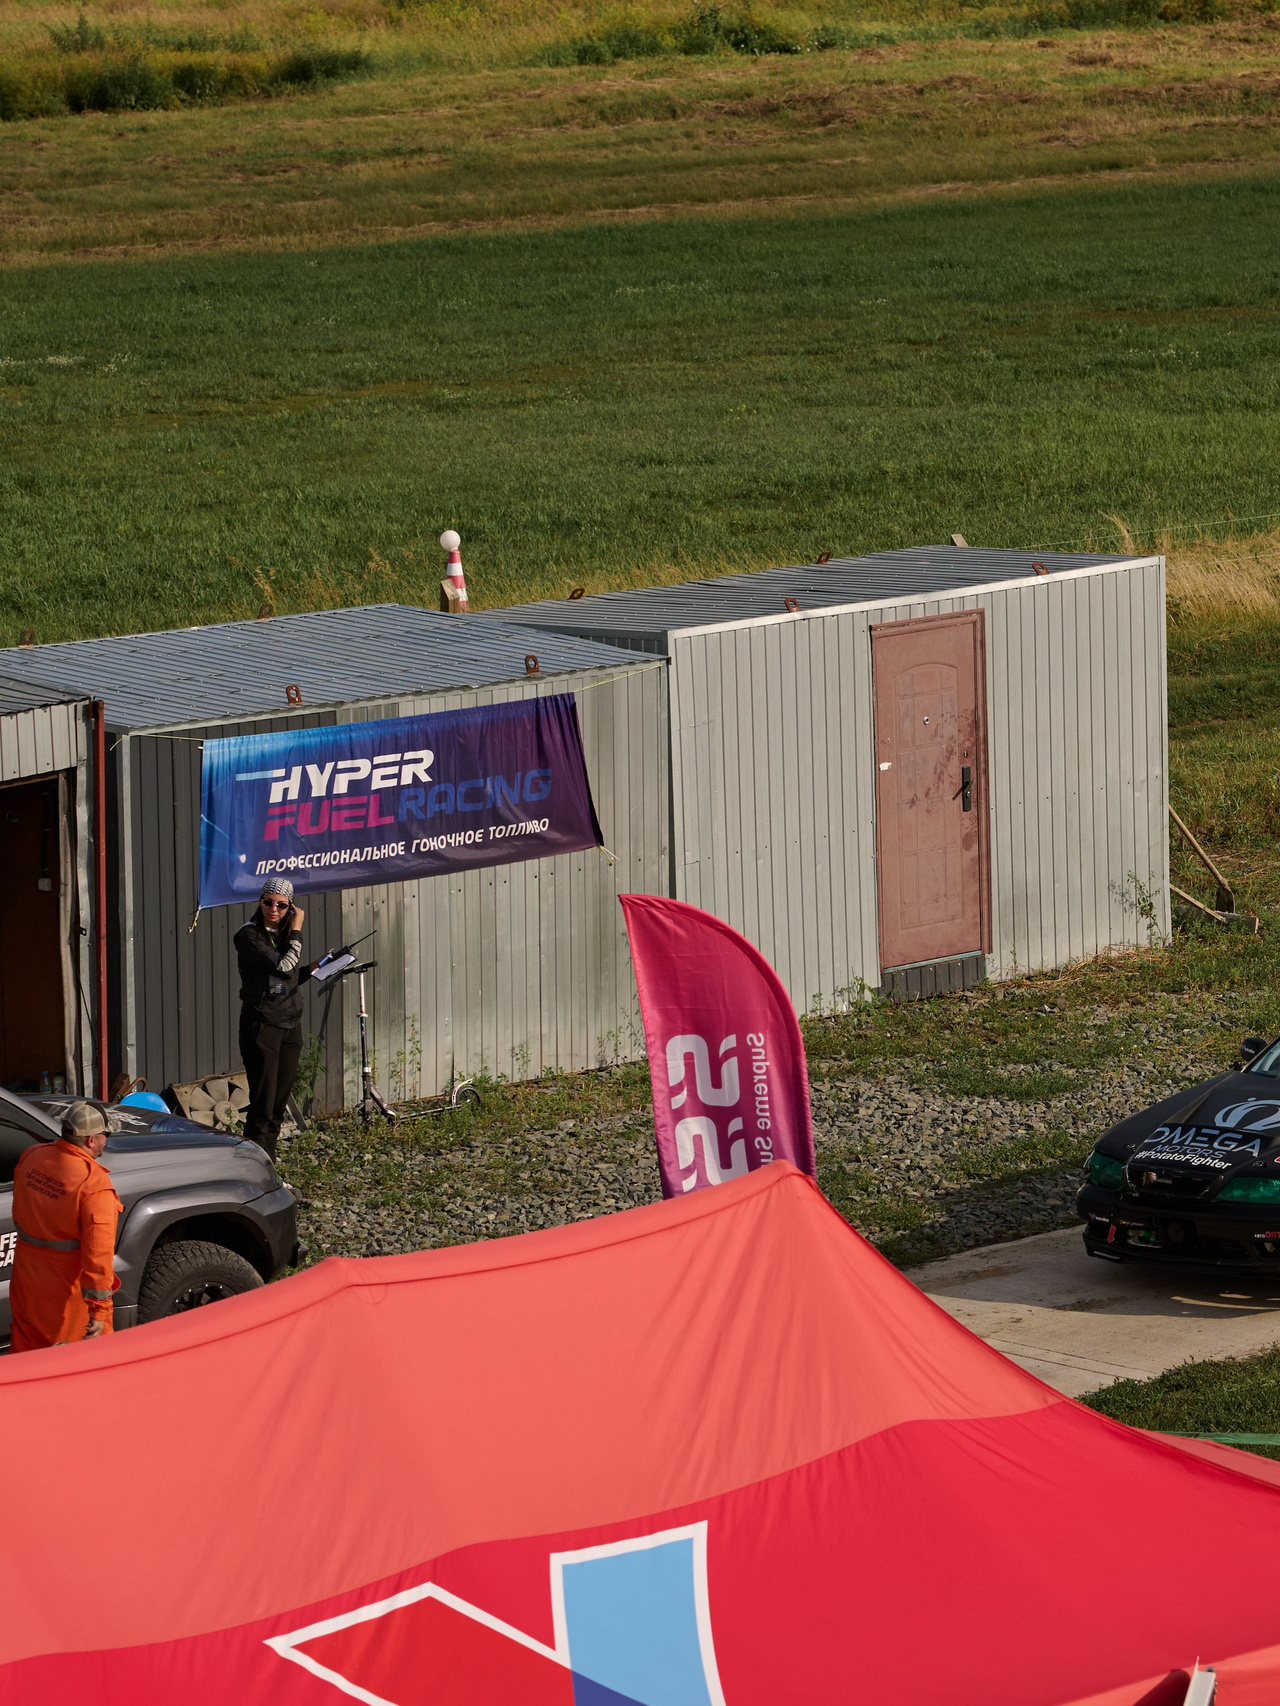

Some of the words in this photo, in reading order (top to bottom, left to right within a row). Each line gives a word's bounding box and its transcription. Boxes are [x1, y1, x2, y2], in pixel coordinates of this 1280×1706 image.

[267, 749, 435, 804] HYPER
[262, 793, 395, 842] FUEL
[397, 767, 553, 823] RACING
[255, 840, 406, 876] ПРОФЕССИОНАЛЬНОЕ
[410, 828, 485, 854] ГОНОЧНОЕ
[488, 817, 550, 841] ТОПЛИВО
[1135, 1150, 1232, 1170] #PotatoFighter
[1144, 1125, 1261, 1159] OMEGA
[1150, 1144, 1227, 1159] MOTORS
